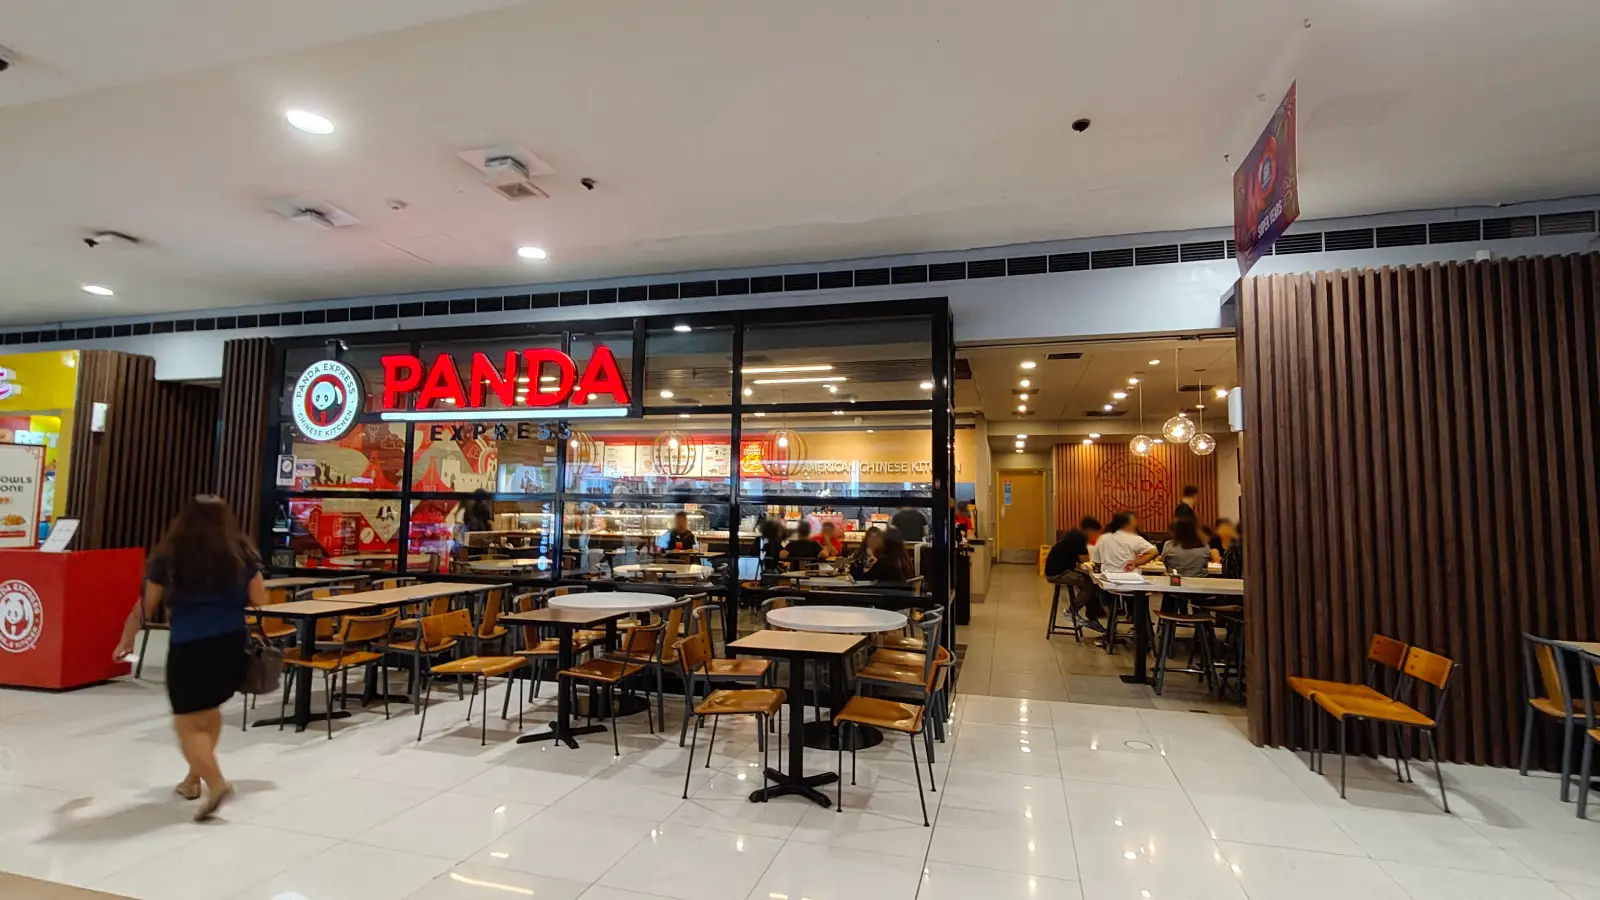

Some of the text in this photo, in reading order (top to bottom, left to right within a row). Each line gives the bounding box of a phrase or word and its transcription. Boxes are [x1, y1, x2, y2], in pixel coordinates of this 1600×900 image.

[296, 363, 356, 398] PANDA EXPRESS
[381, 345, 632, 409] PANDA
[297, 409, 353, 437] CHINESE KITCHEN
[429, 421, 573, 442] EXPRESS
[801, 461, 962, 474] AMERICAN CHINESE KITN
